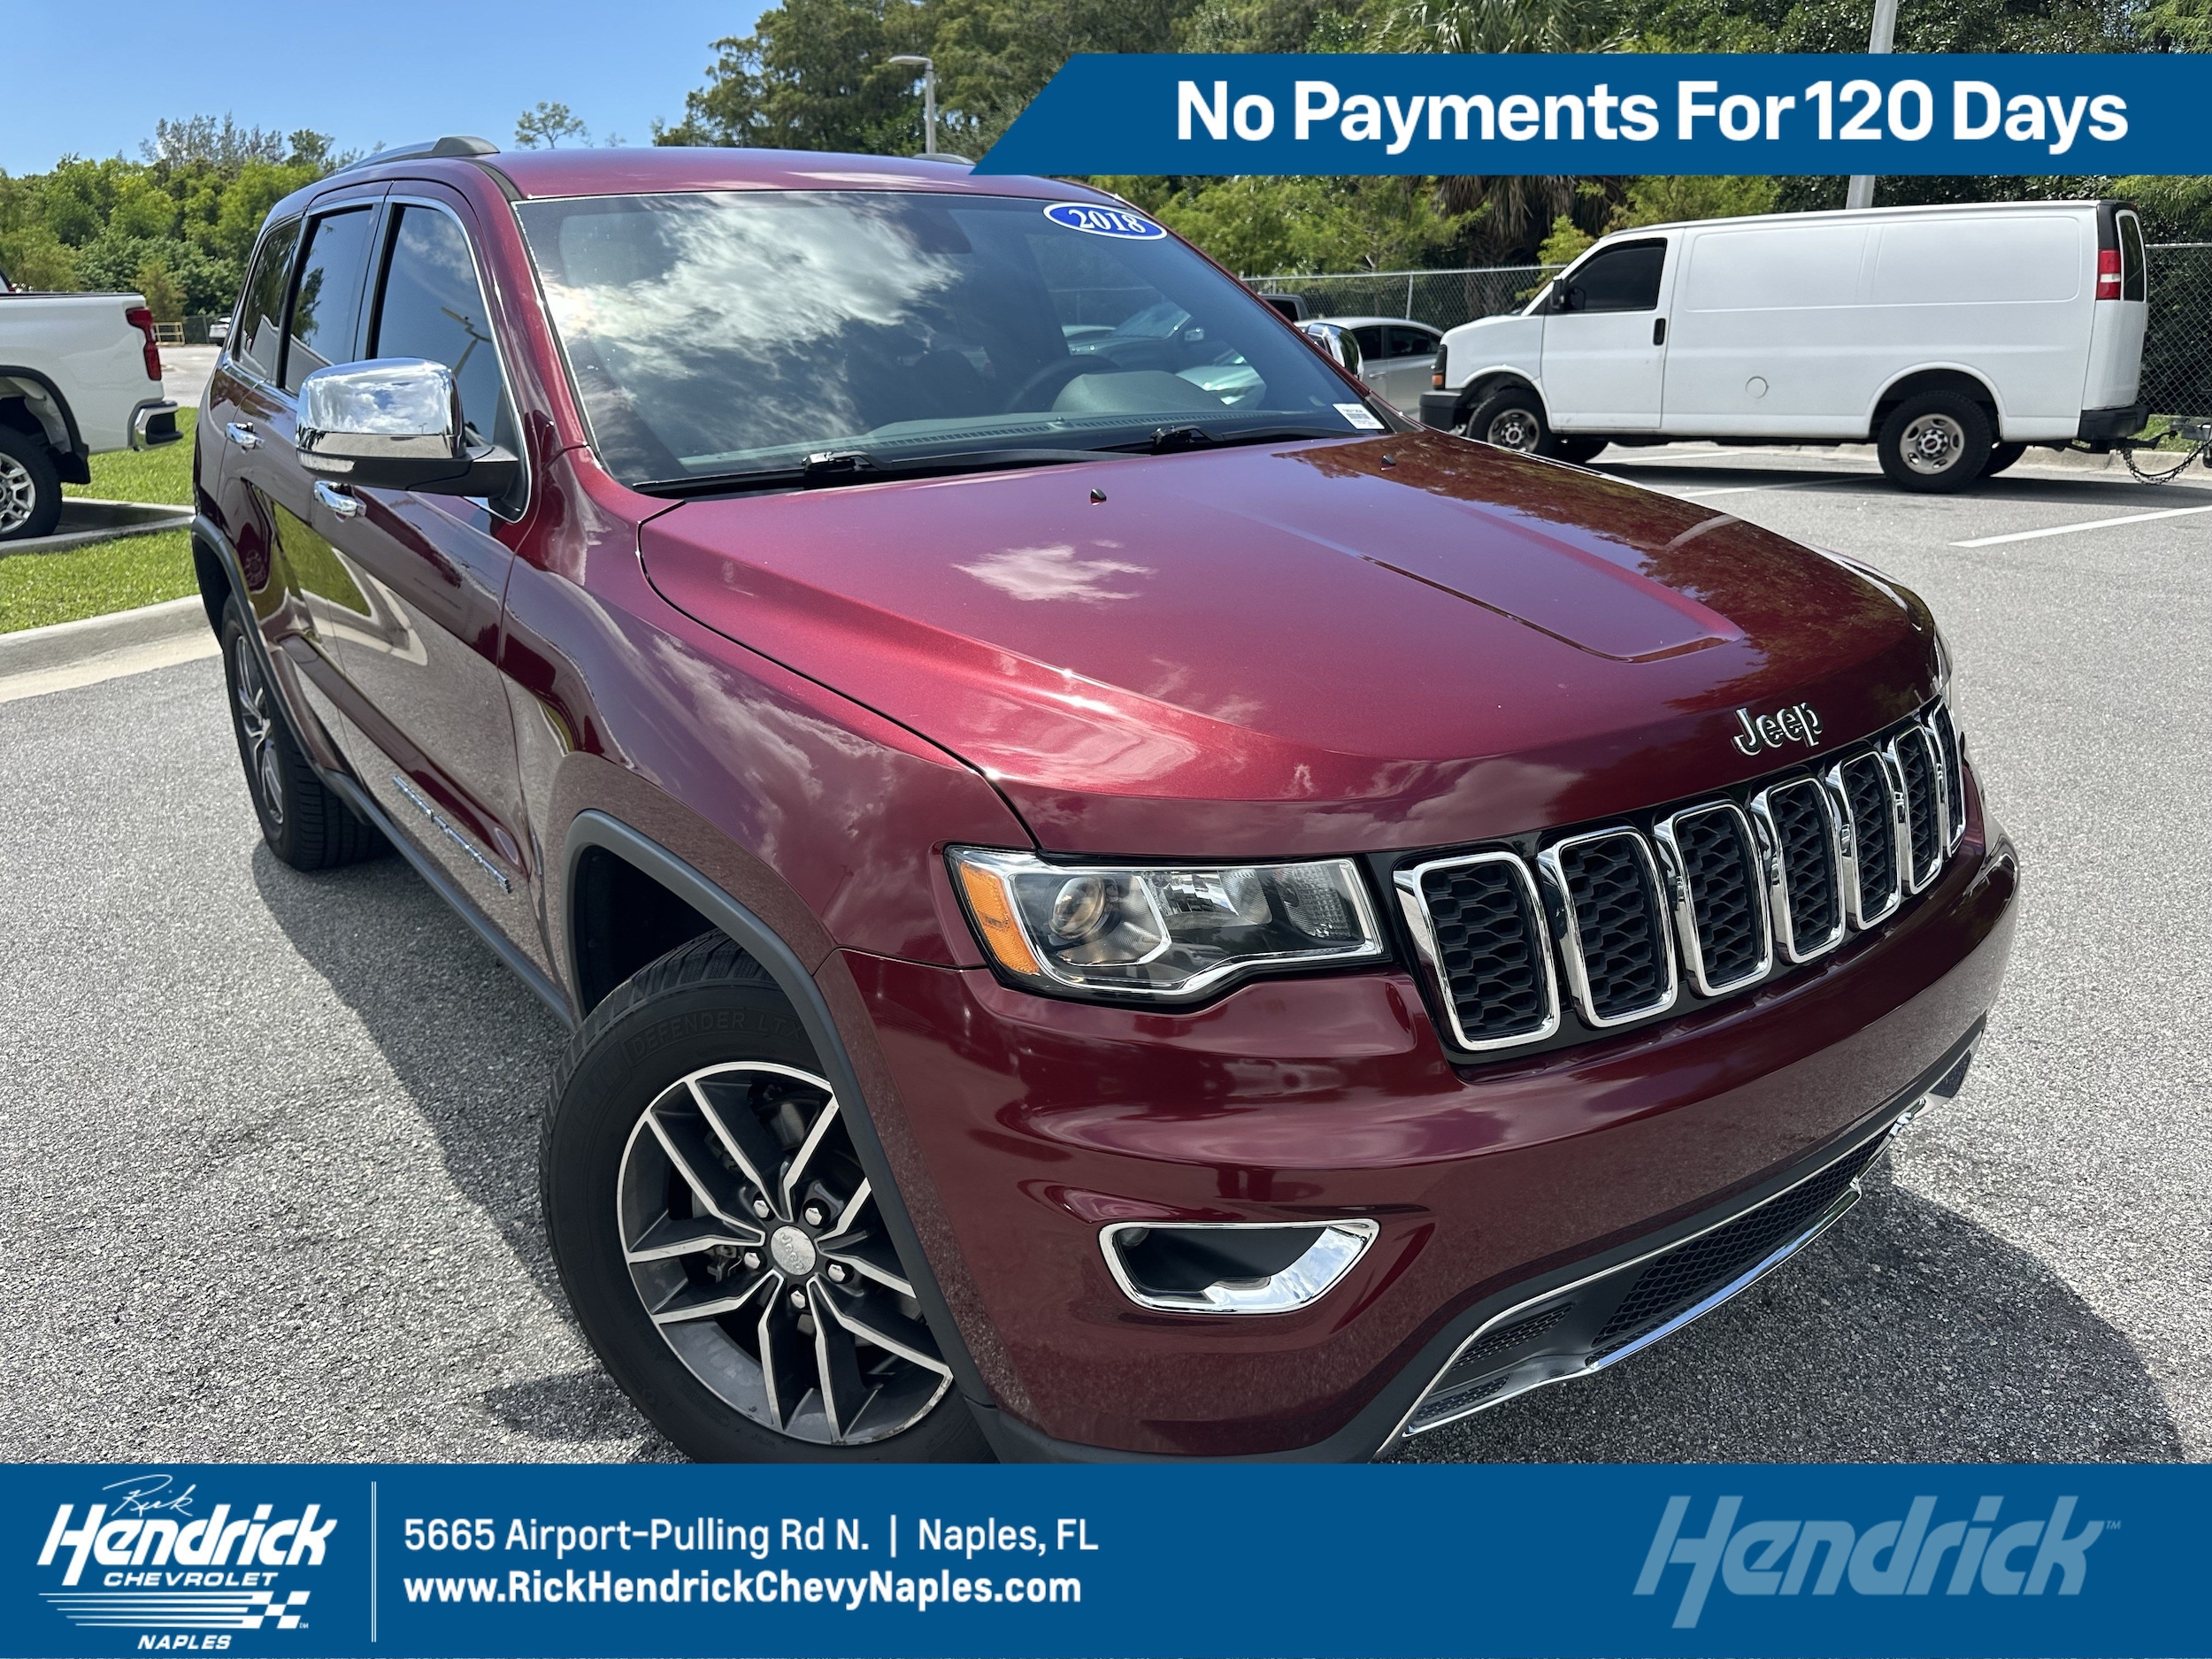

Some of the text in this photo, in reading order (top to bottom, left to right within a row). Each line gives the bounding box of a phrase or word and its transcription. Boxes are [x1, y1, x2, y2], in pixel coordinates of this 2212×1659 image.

[1068, 209, 1147, 234] 2018
[1732, 702, 1823, 757] Jeep
[632, 1010, 747, 1057] DEFENDER
